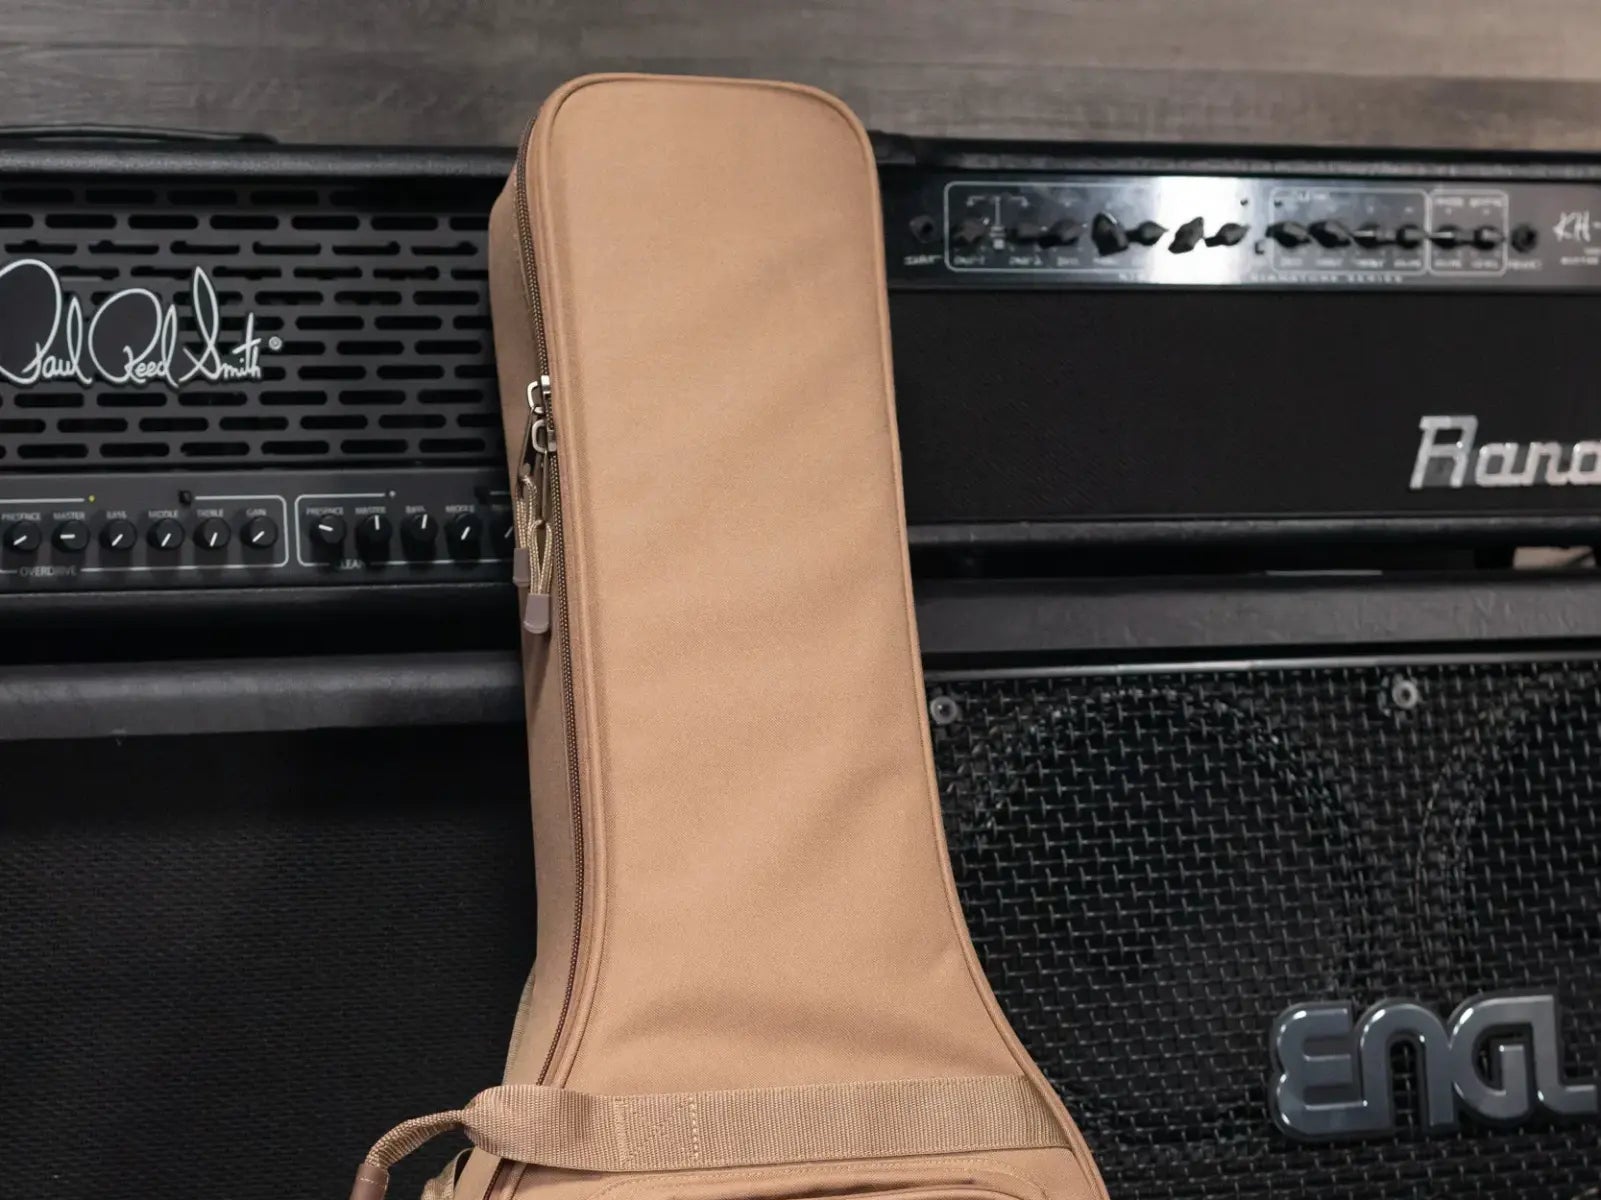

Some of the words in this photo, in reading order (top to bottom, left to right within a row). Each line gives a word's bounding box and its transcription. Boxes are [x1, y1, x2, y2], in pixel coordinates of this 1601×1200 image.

[0, 258, 92, 386] Paul
[88, 288, 180, 387] Reed
[1272, 993, 1599, 1138] ENGL
